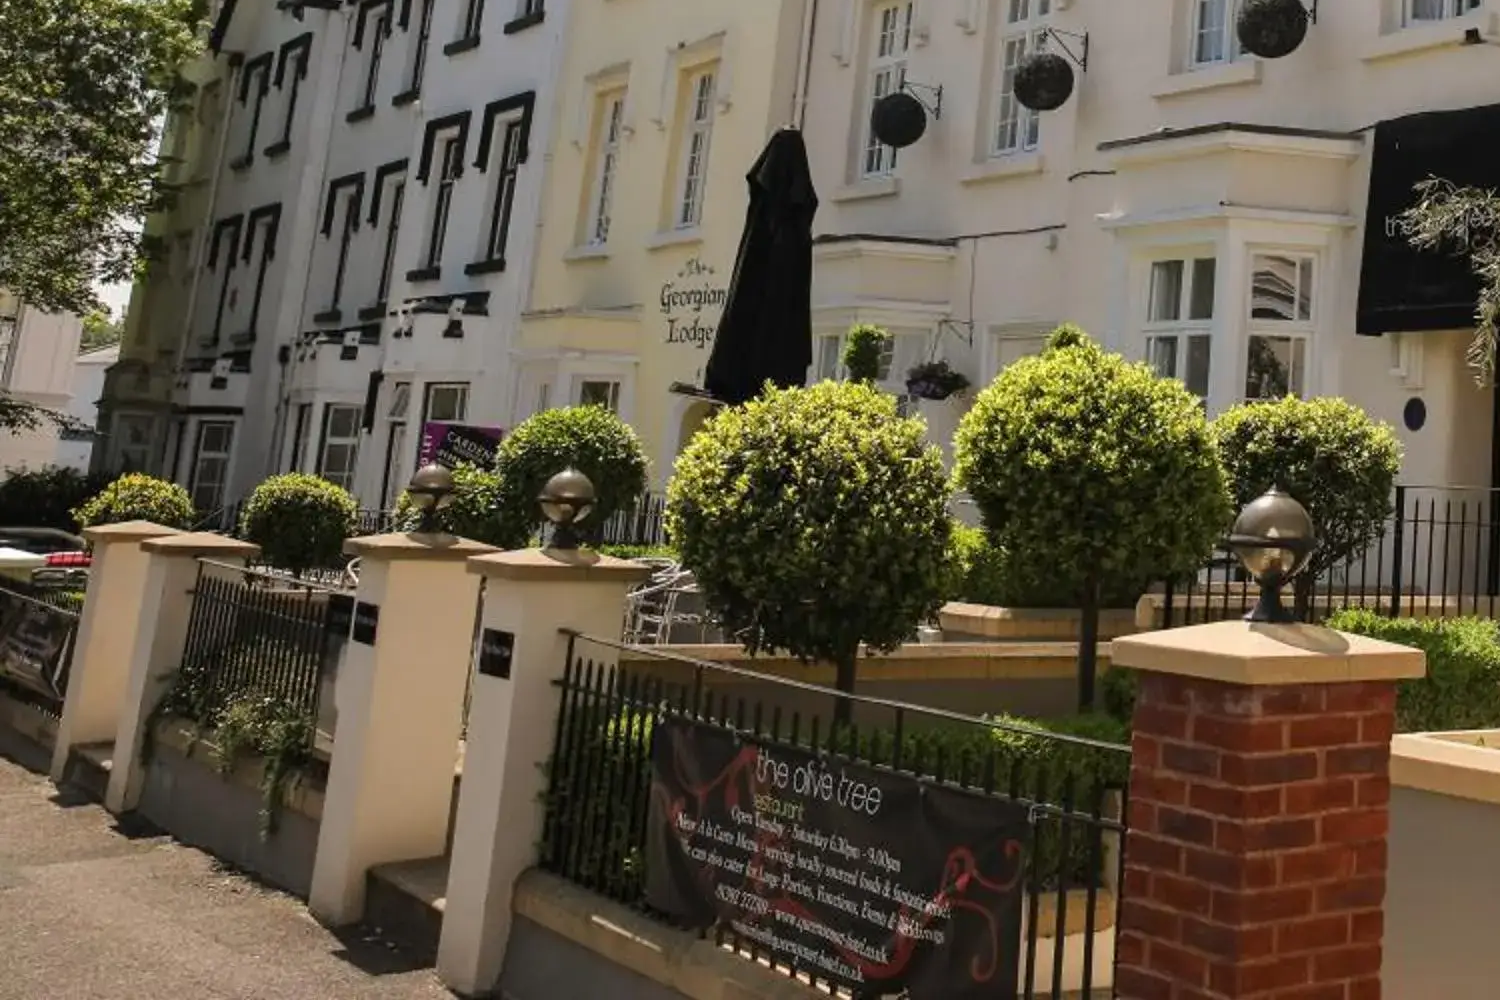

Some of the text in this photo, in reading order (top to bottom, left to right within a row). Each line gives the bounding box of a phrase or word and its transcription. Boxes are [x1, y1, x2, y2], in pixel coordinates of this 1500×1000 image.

[660, 283, 726, 314] Georgian
[666, 316, 713, 348] Lodge
[756, 748, 881, 815] the olive tree
[731, 804, 753, 825] Open
[755, 810, 785, 839] Tuesday
[793, 823, 829, 851] Saturday
